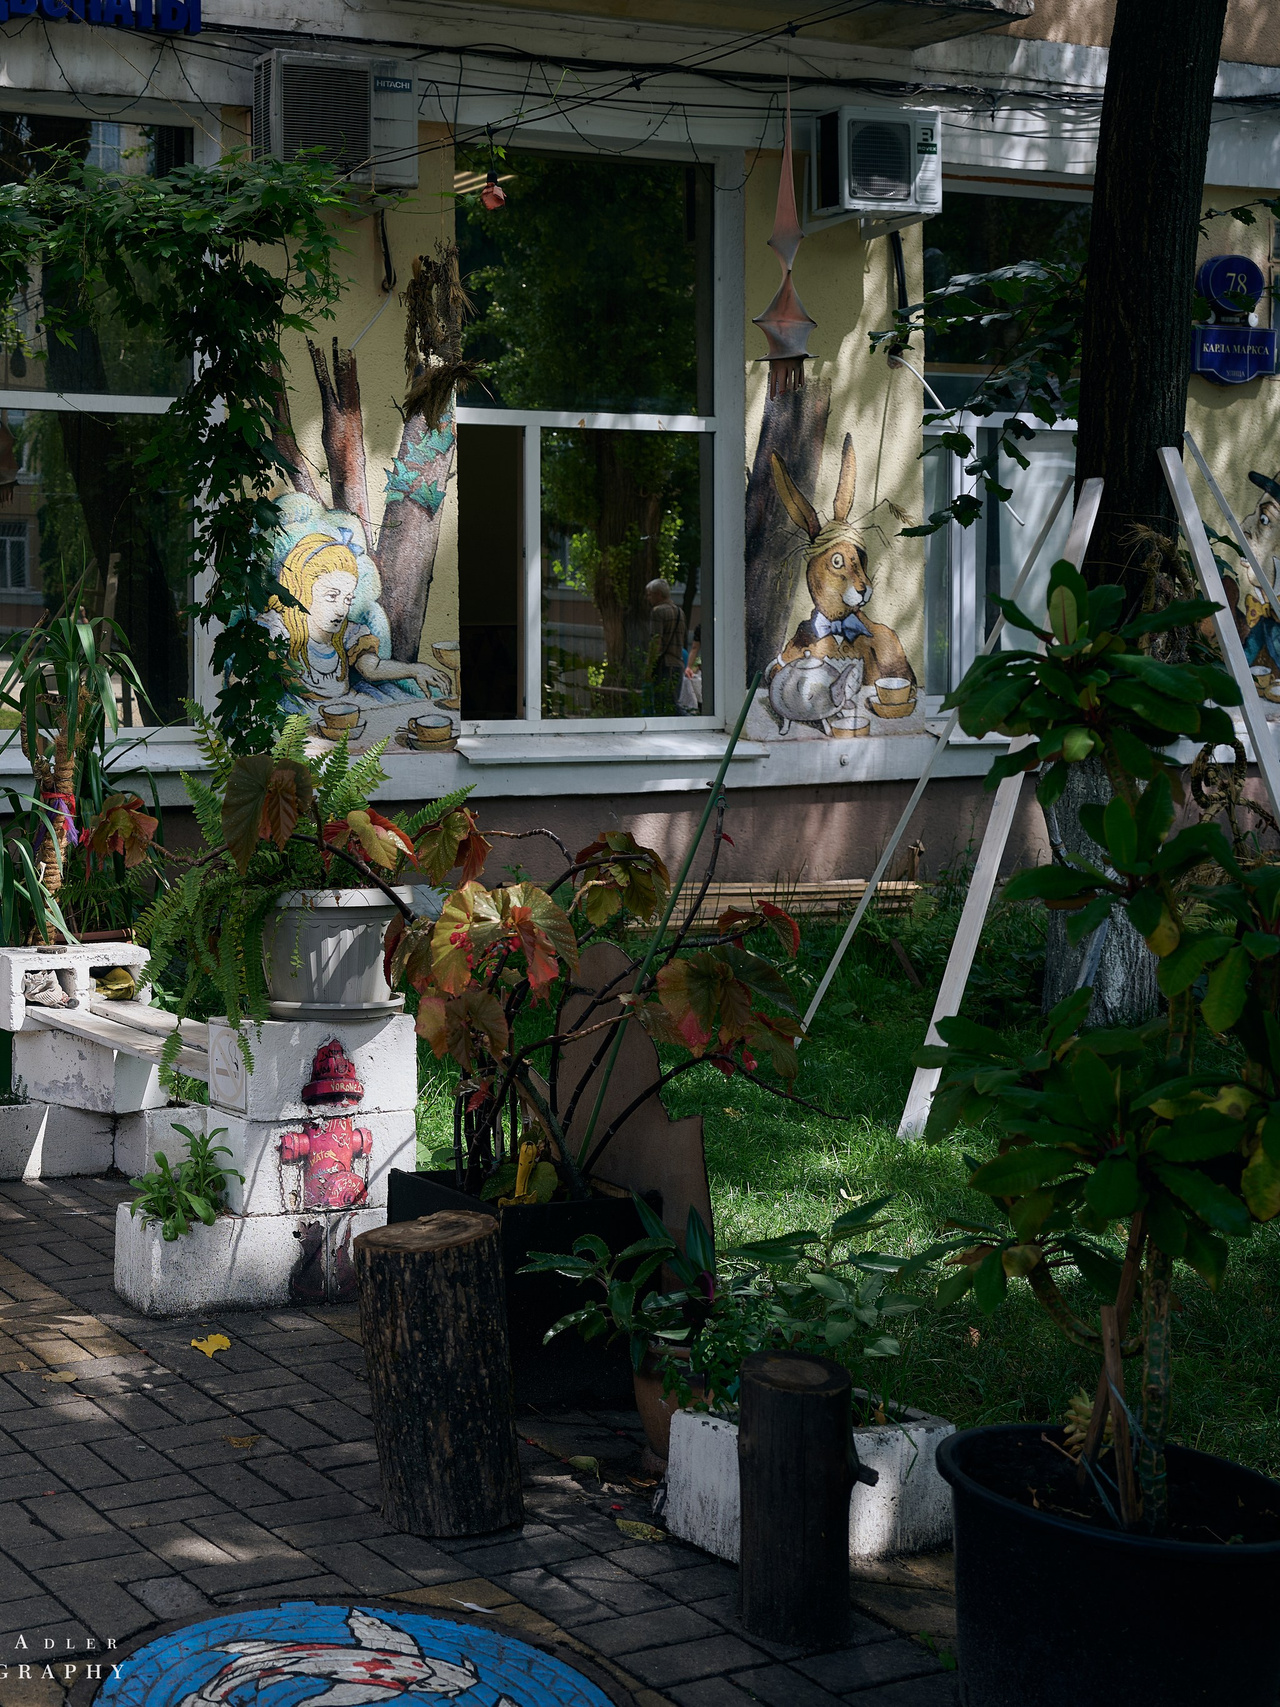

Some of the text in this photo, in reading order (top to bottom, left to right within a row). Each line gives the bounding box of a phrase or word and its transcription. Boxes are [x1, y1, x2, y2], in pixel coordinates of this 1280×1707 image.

[376, 79, 411, 89] HITACHI
[1225, 272, 1248, 296] 78
[1202, 342, 1270, 356] КАРЛА МАРКСА
[1226, 369, 1246, 378] УЛИЦА
